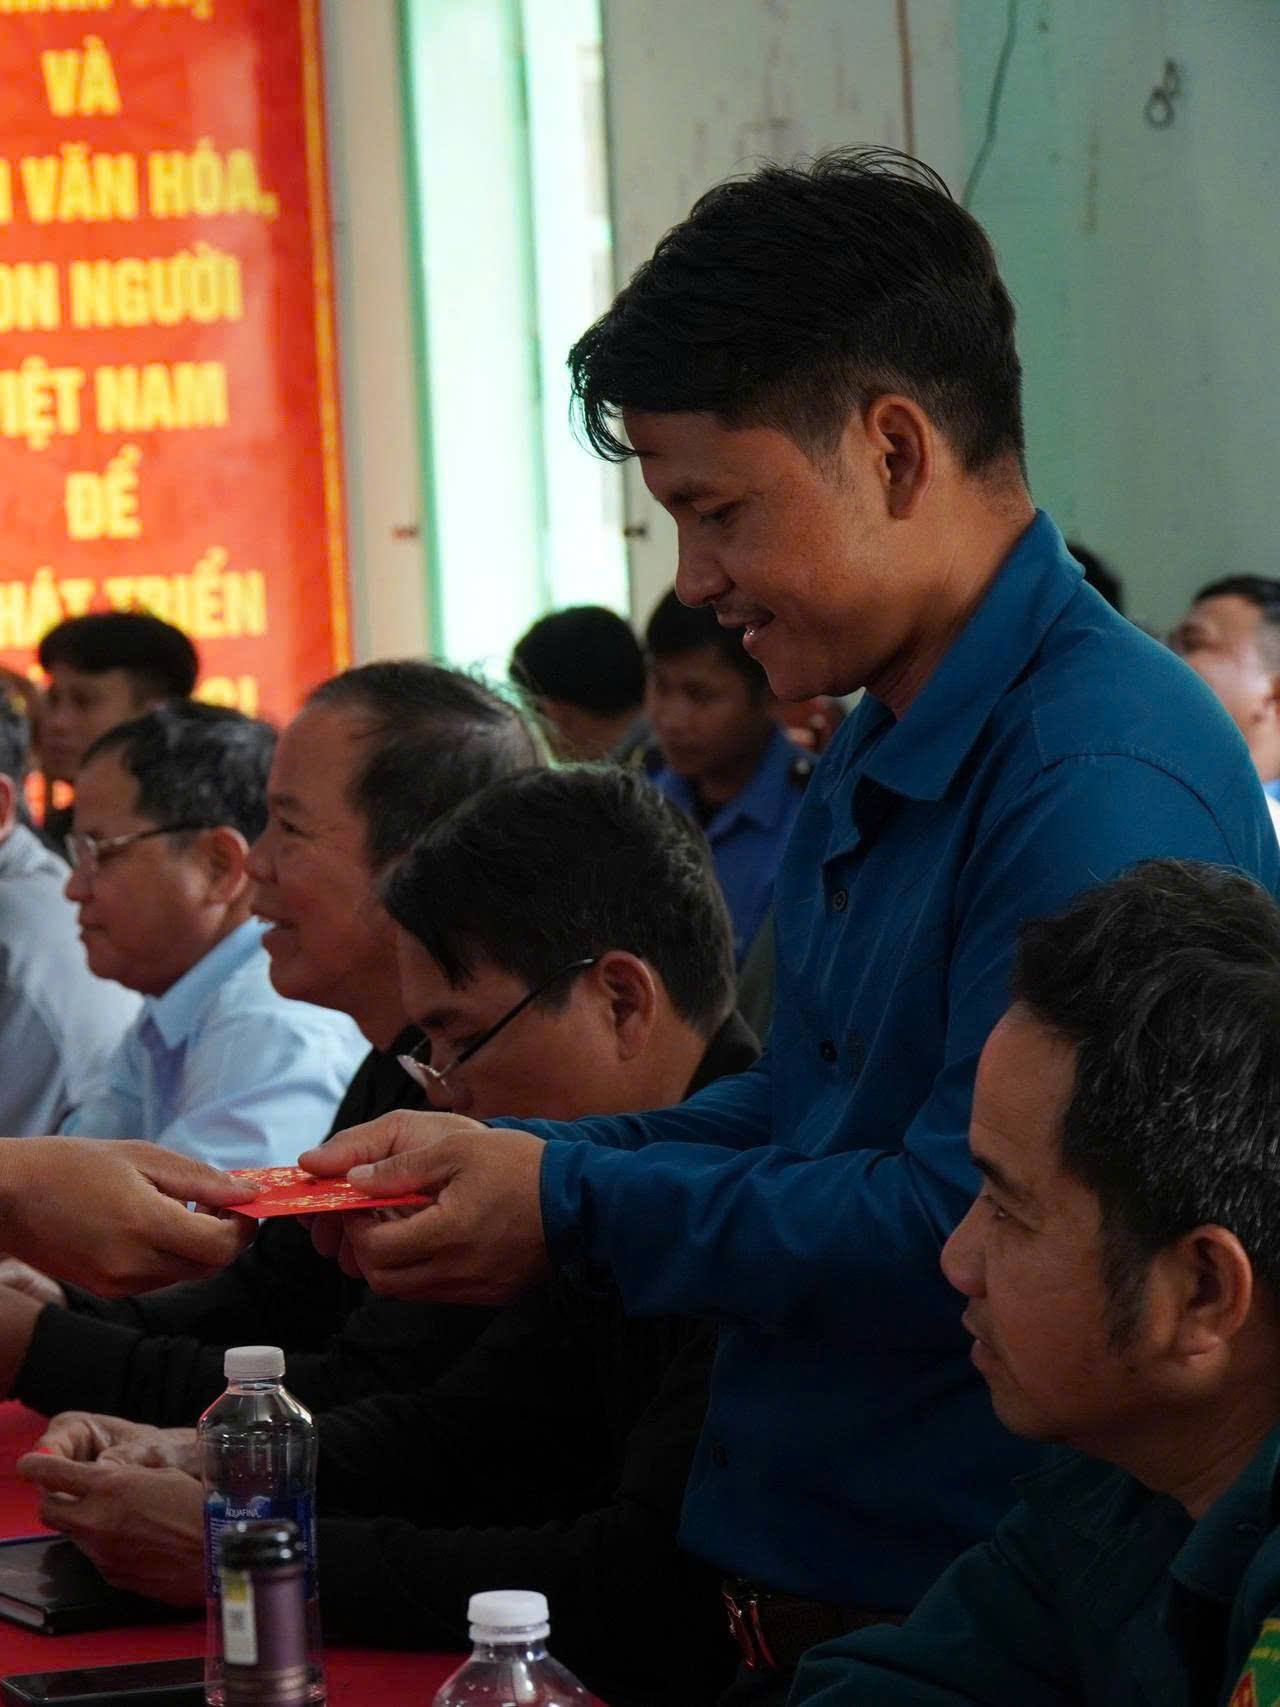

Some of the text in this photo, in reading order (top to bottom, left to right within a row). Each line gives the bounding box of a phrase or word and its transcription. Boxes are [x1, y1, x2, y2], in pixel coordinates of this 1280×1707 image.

[42, 35, 121, 116] VÀ
[21, 142, 138, 224] VĂN
[70, 241, 243, 328] NGƯỜI
[95, 362, 228, 431] NAM
[225, 1507, 259, 1519] AQUAFINA
